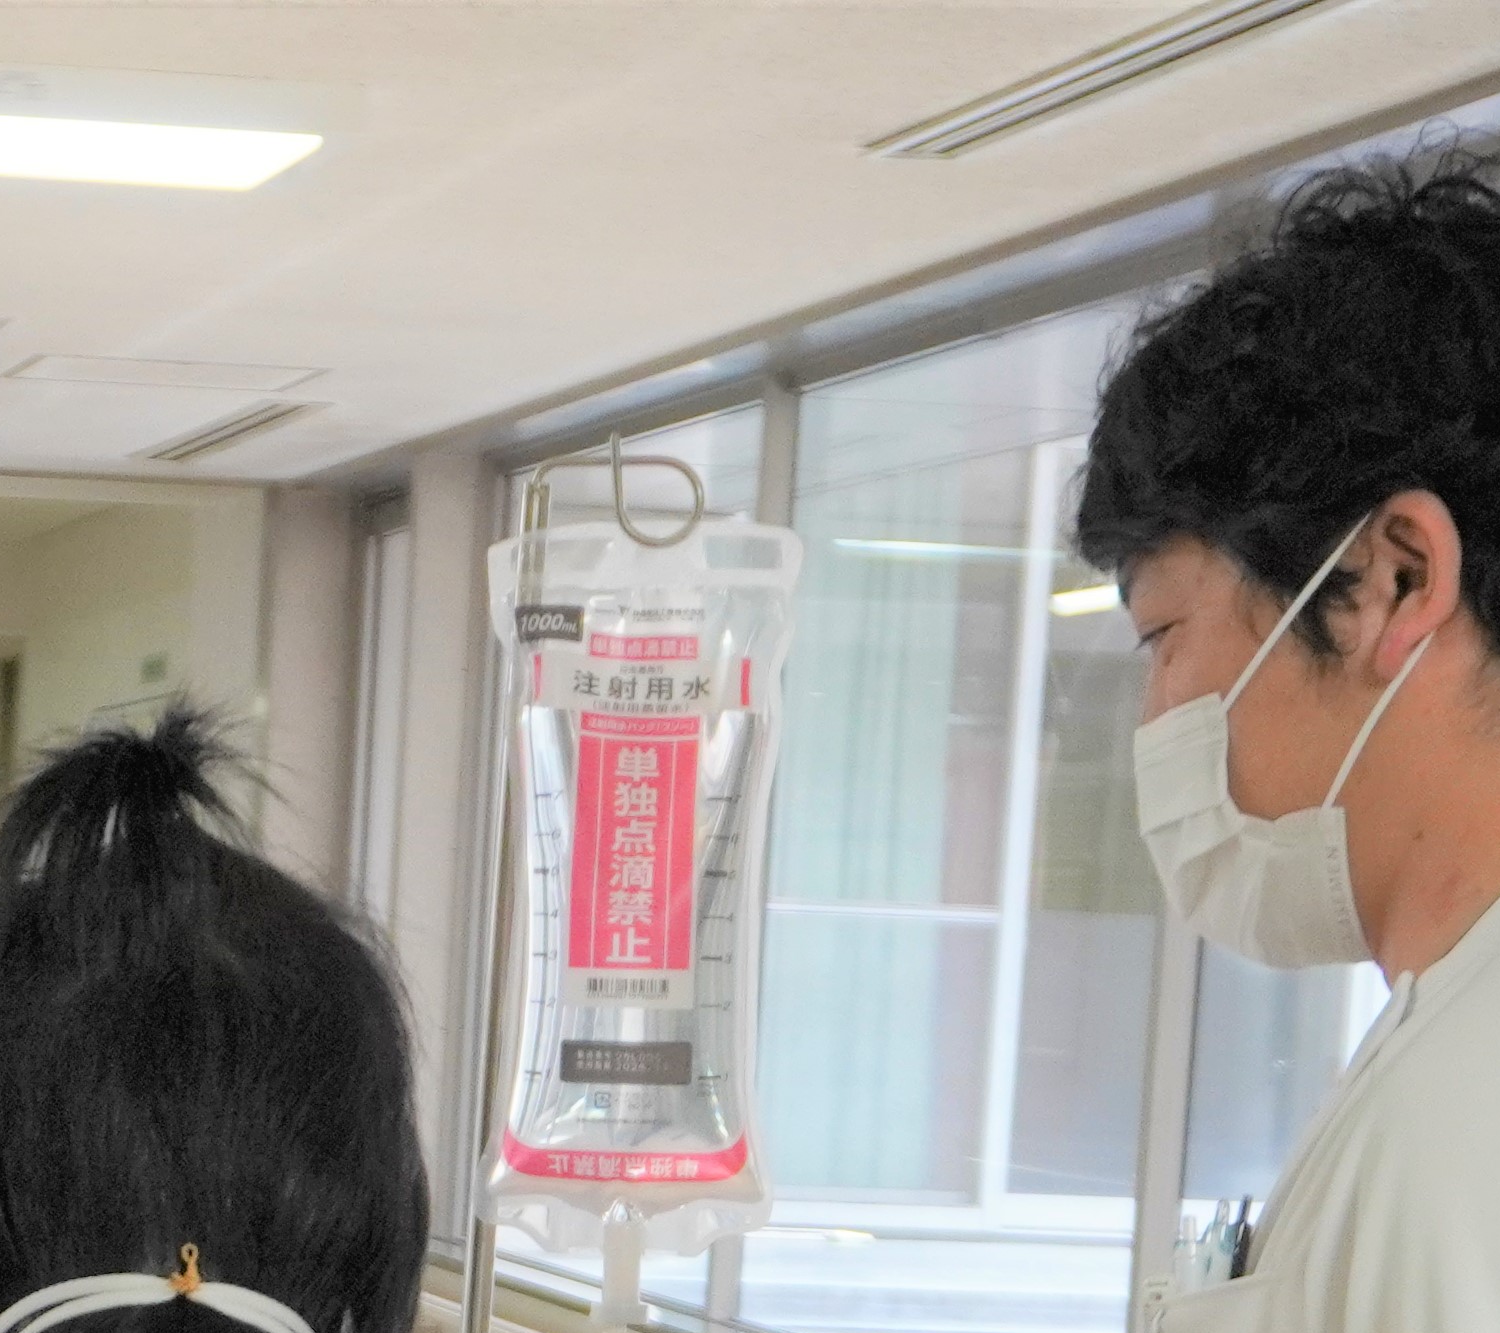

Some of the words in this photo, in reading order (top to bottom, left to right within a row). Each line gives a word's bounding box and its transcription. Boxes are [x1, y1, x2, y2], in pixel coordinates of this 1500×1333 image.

[521, 613, 577, 634] 1000mL
[573, 669, 711, 701] 注射用水
[606, 748, 659, 964] 単独点滴禁止
[547, 1153, 700, 1179] 単独点滴禁止
